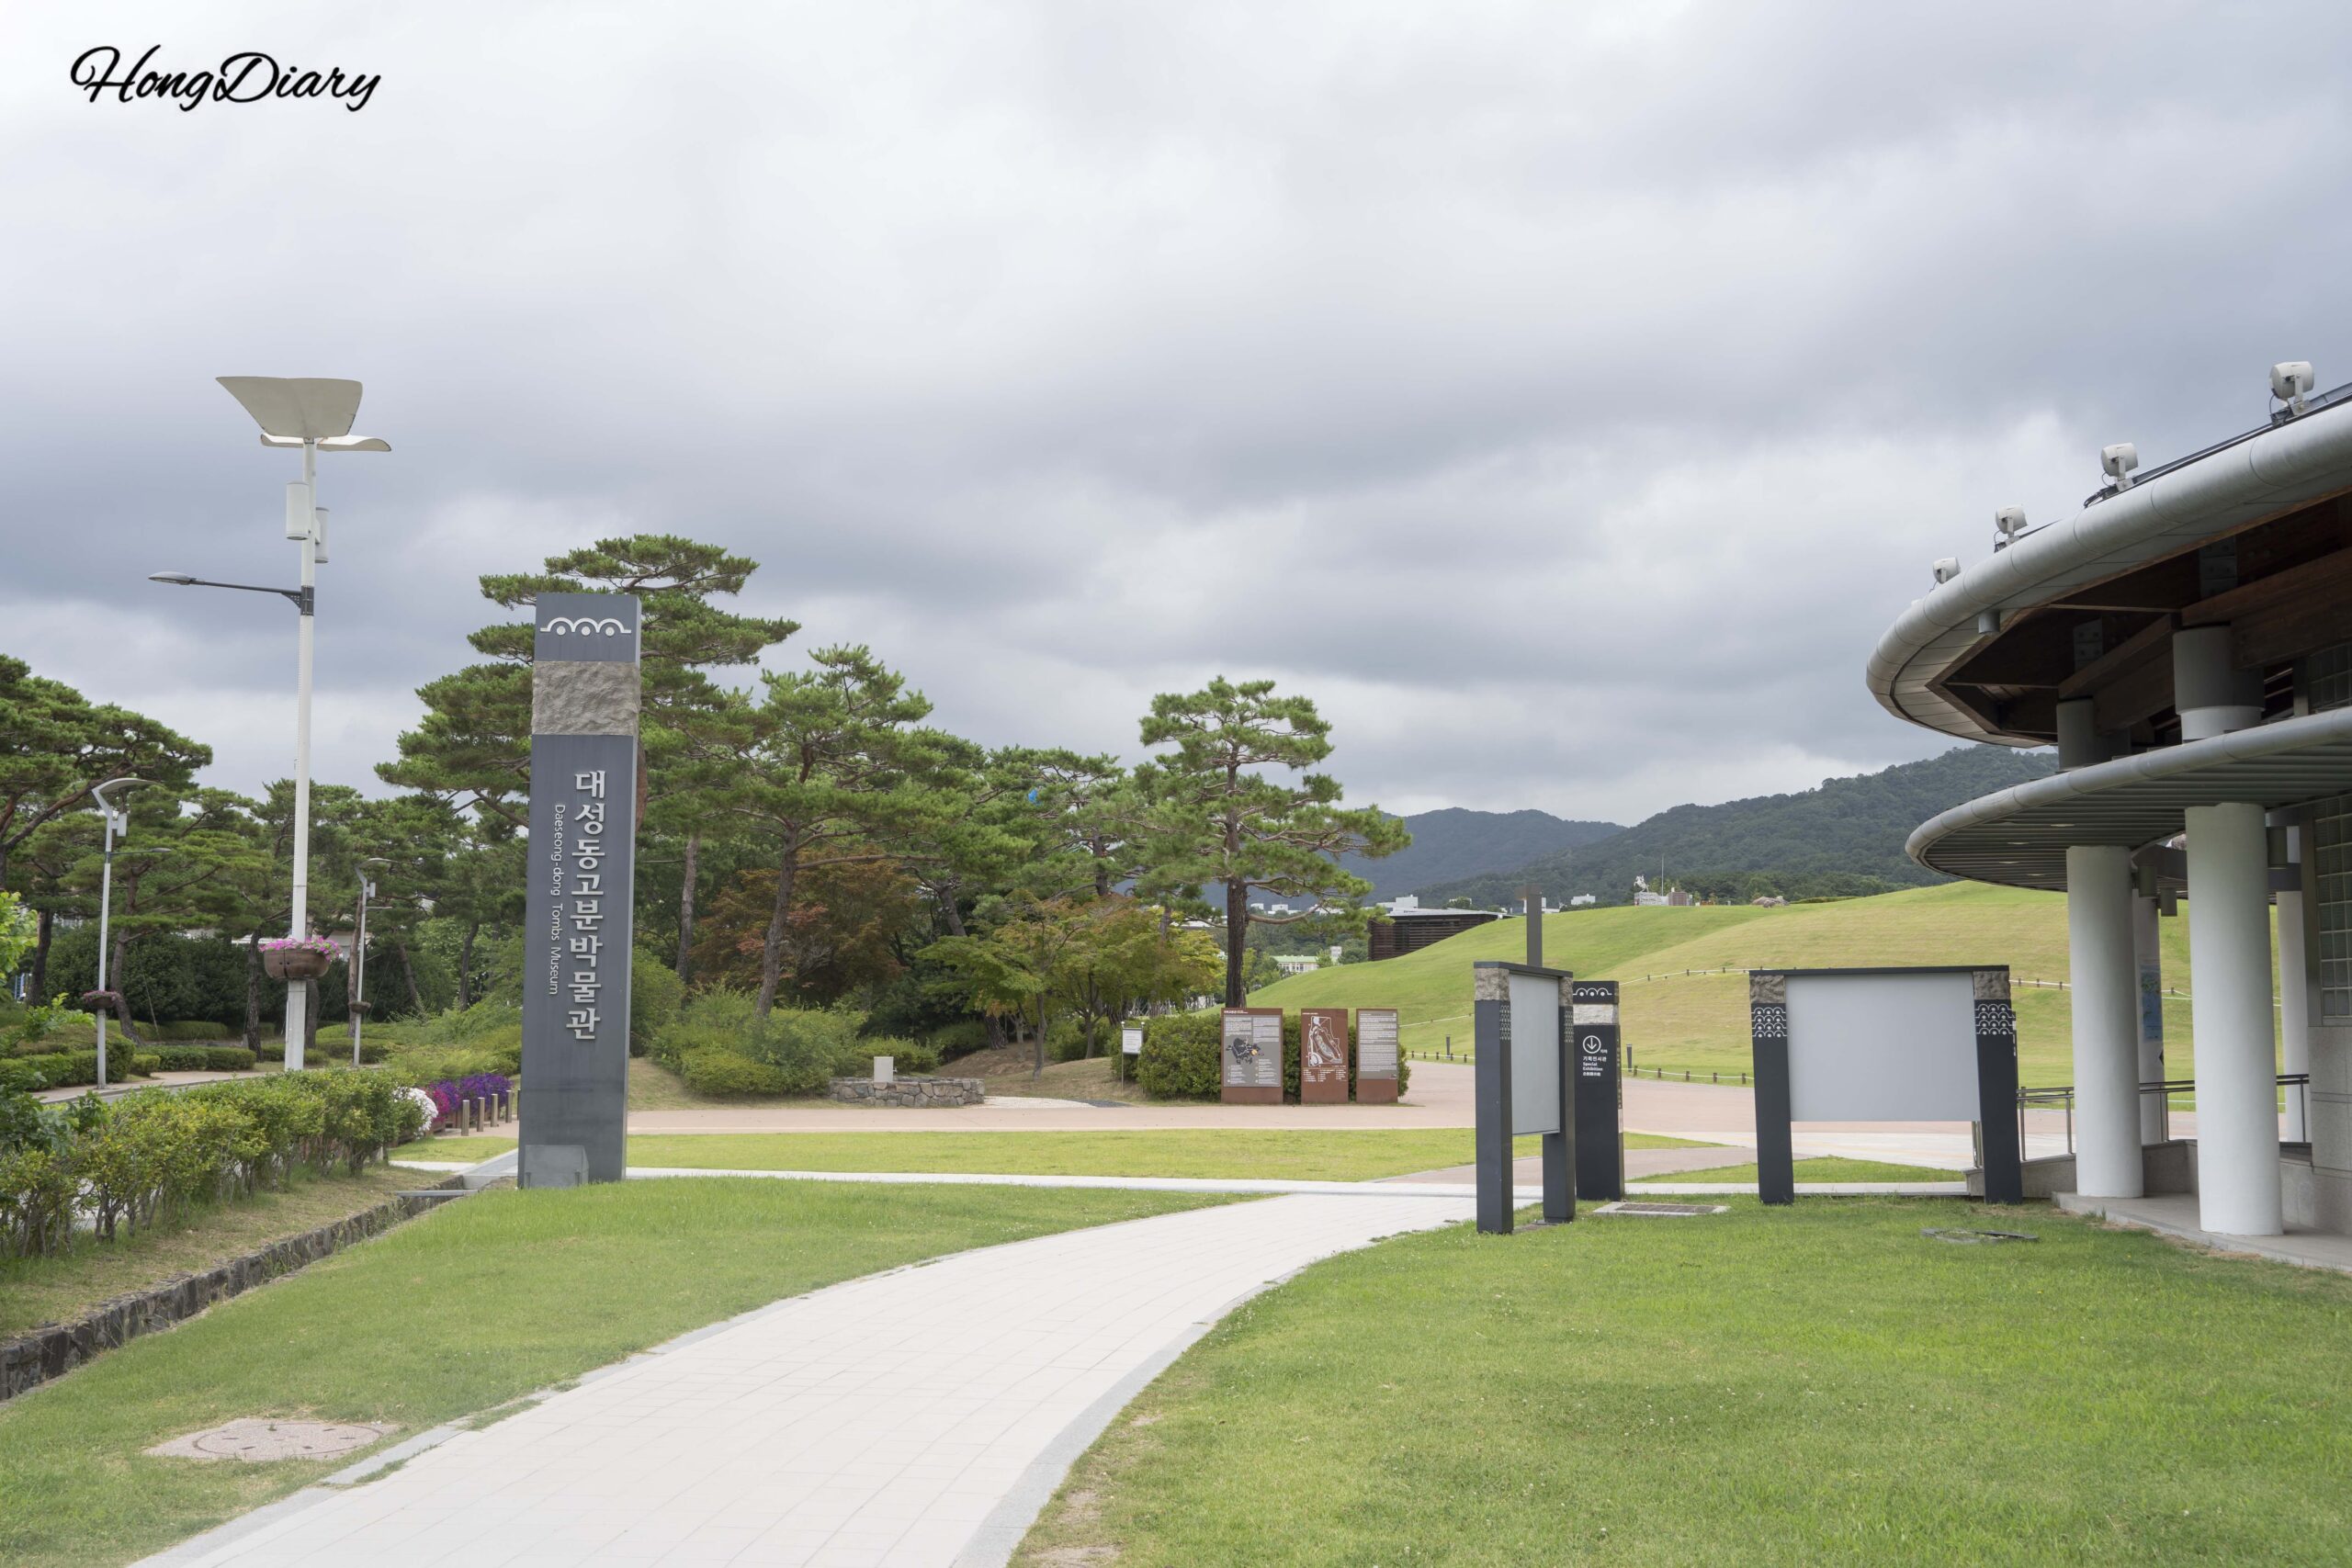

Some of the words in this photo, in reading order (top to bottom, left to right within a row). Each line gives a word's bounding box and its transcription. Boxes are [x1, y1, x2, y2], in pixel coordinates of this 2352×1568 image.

[550, 804, 566, 897] Daeseong-dong
[551, 903, 563, 941] Tombs
[566, 770, 606, 1040] 대성동고분박물관
[549, 947, 561, 995] Museum
